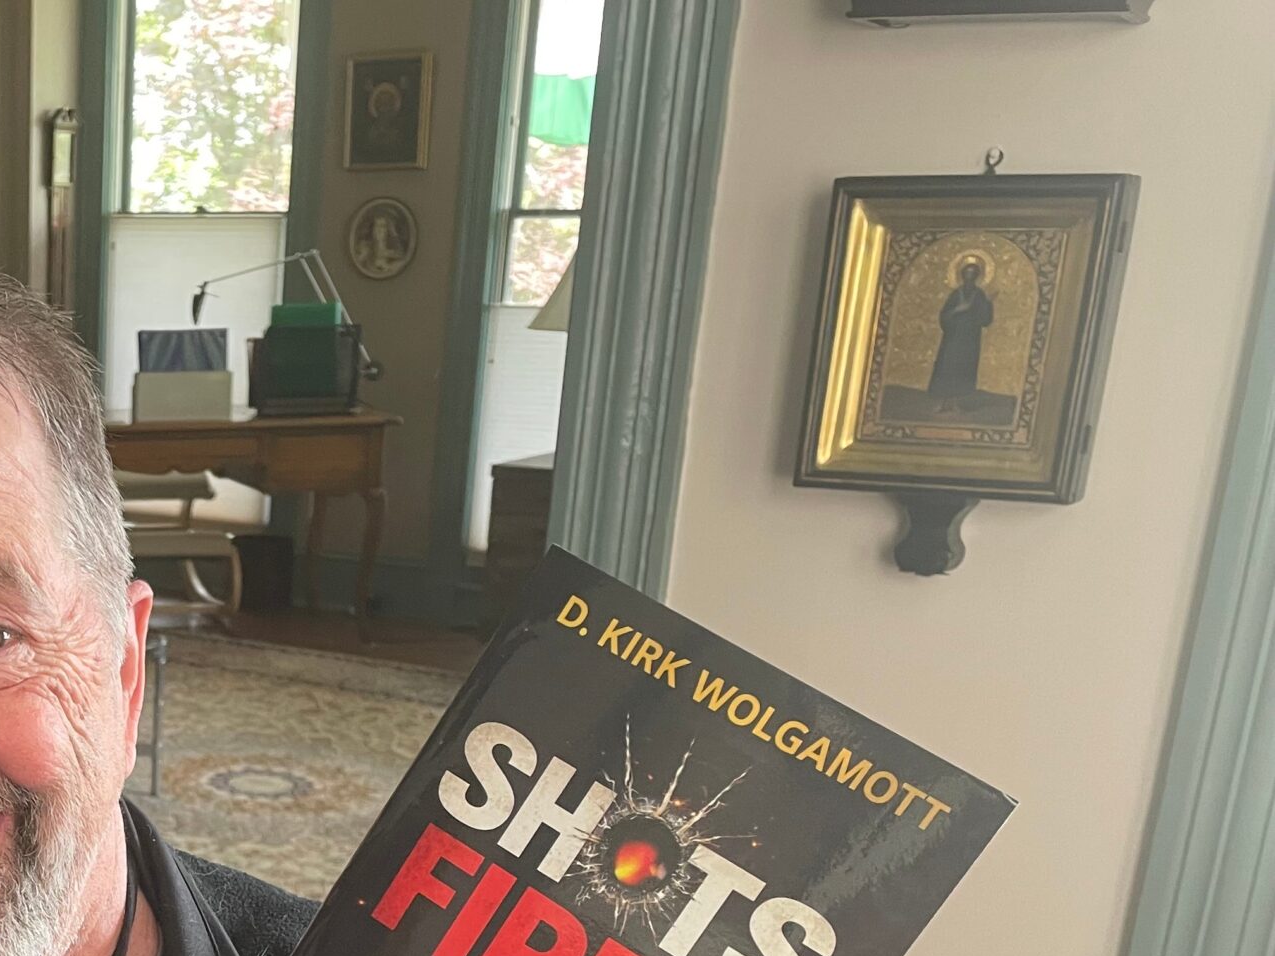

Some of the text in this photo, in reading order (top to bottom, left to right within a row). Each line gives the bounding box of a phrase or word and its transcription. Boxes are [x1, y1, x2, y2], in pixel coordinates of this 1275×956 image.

[556, 594, 951, 831] D. KIRK WOLGAMOTT
